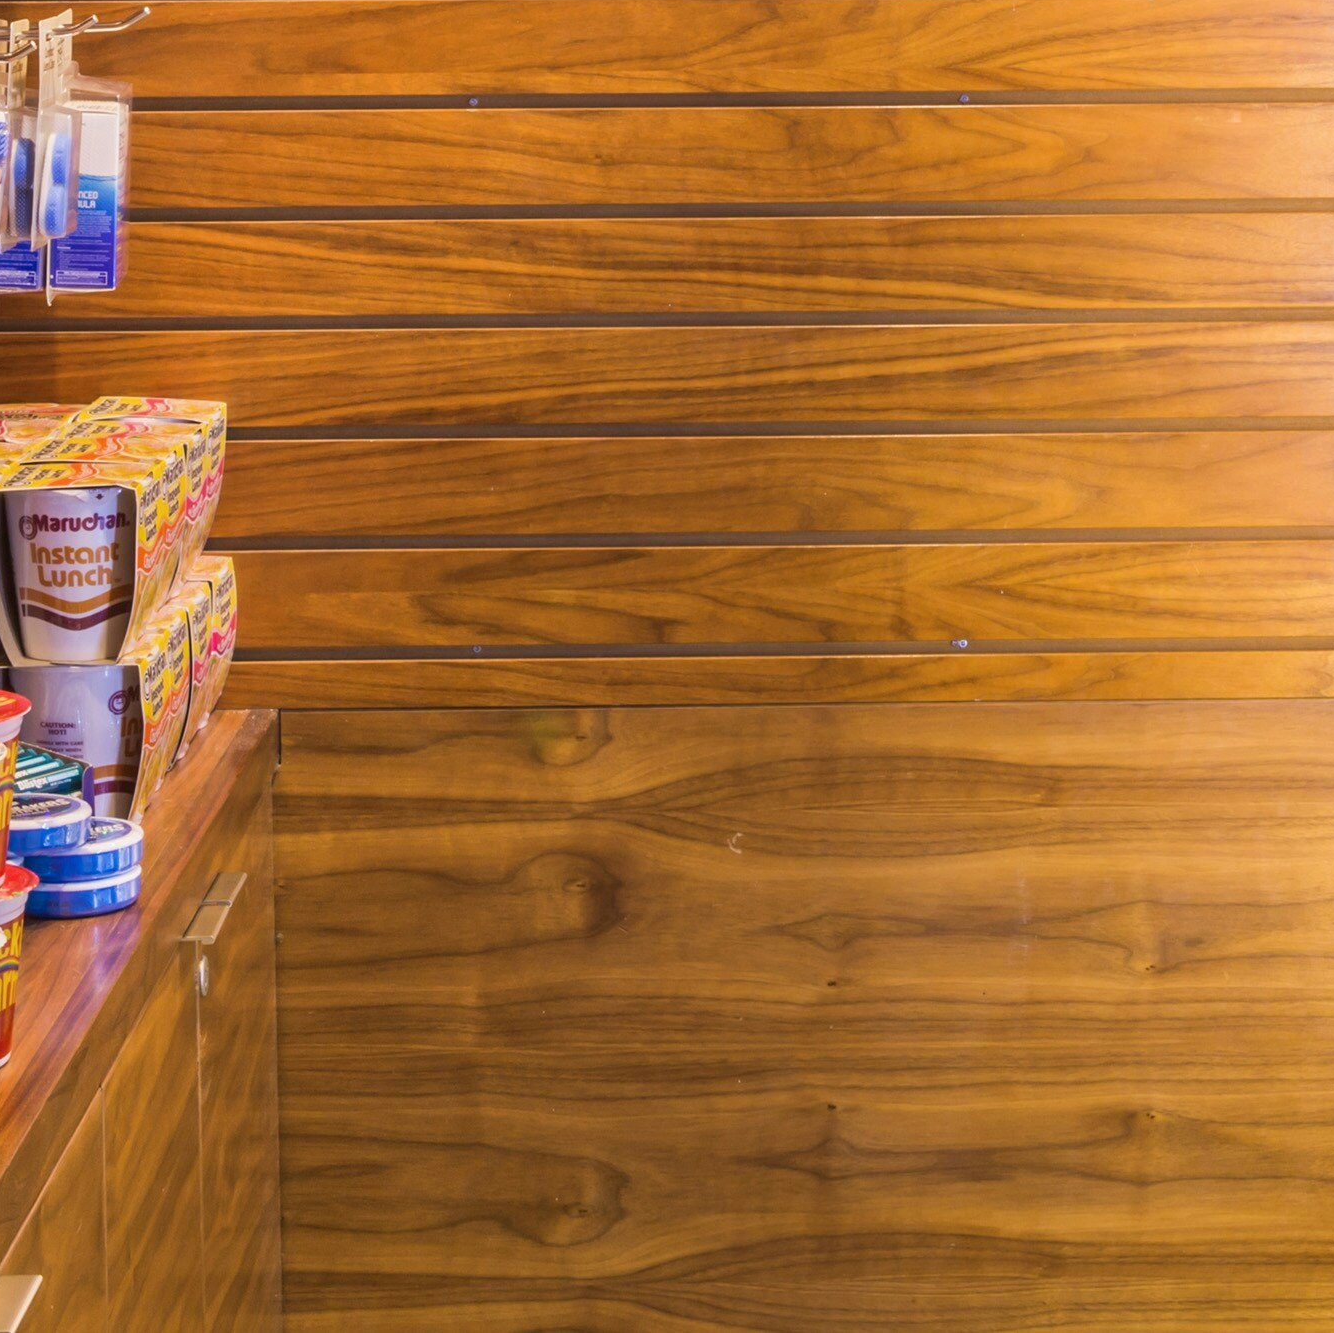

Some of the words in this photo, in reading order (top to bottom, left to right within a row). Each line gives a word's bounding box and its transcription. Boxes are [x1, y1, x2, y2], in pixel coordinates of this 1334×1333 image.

[30, 542, 121, 566] Instant
[38, 567, 115, 588] Lunch
[40, 721, 77, 730] CAUTION:
[17, 776, 47, 791] Blistex
